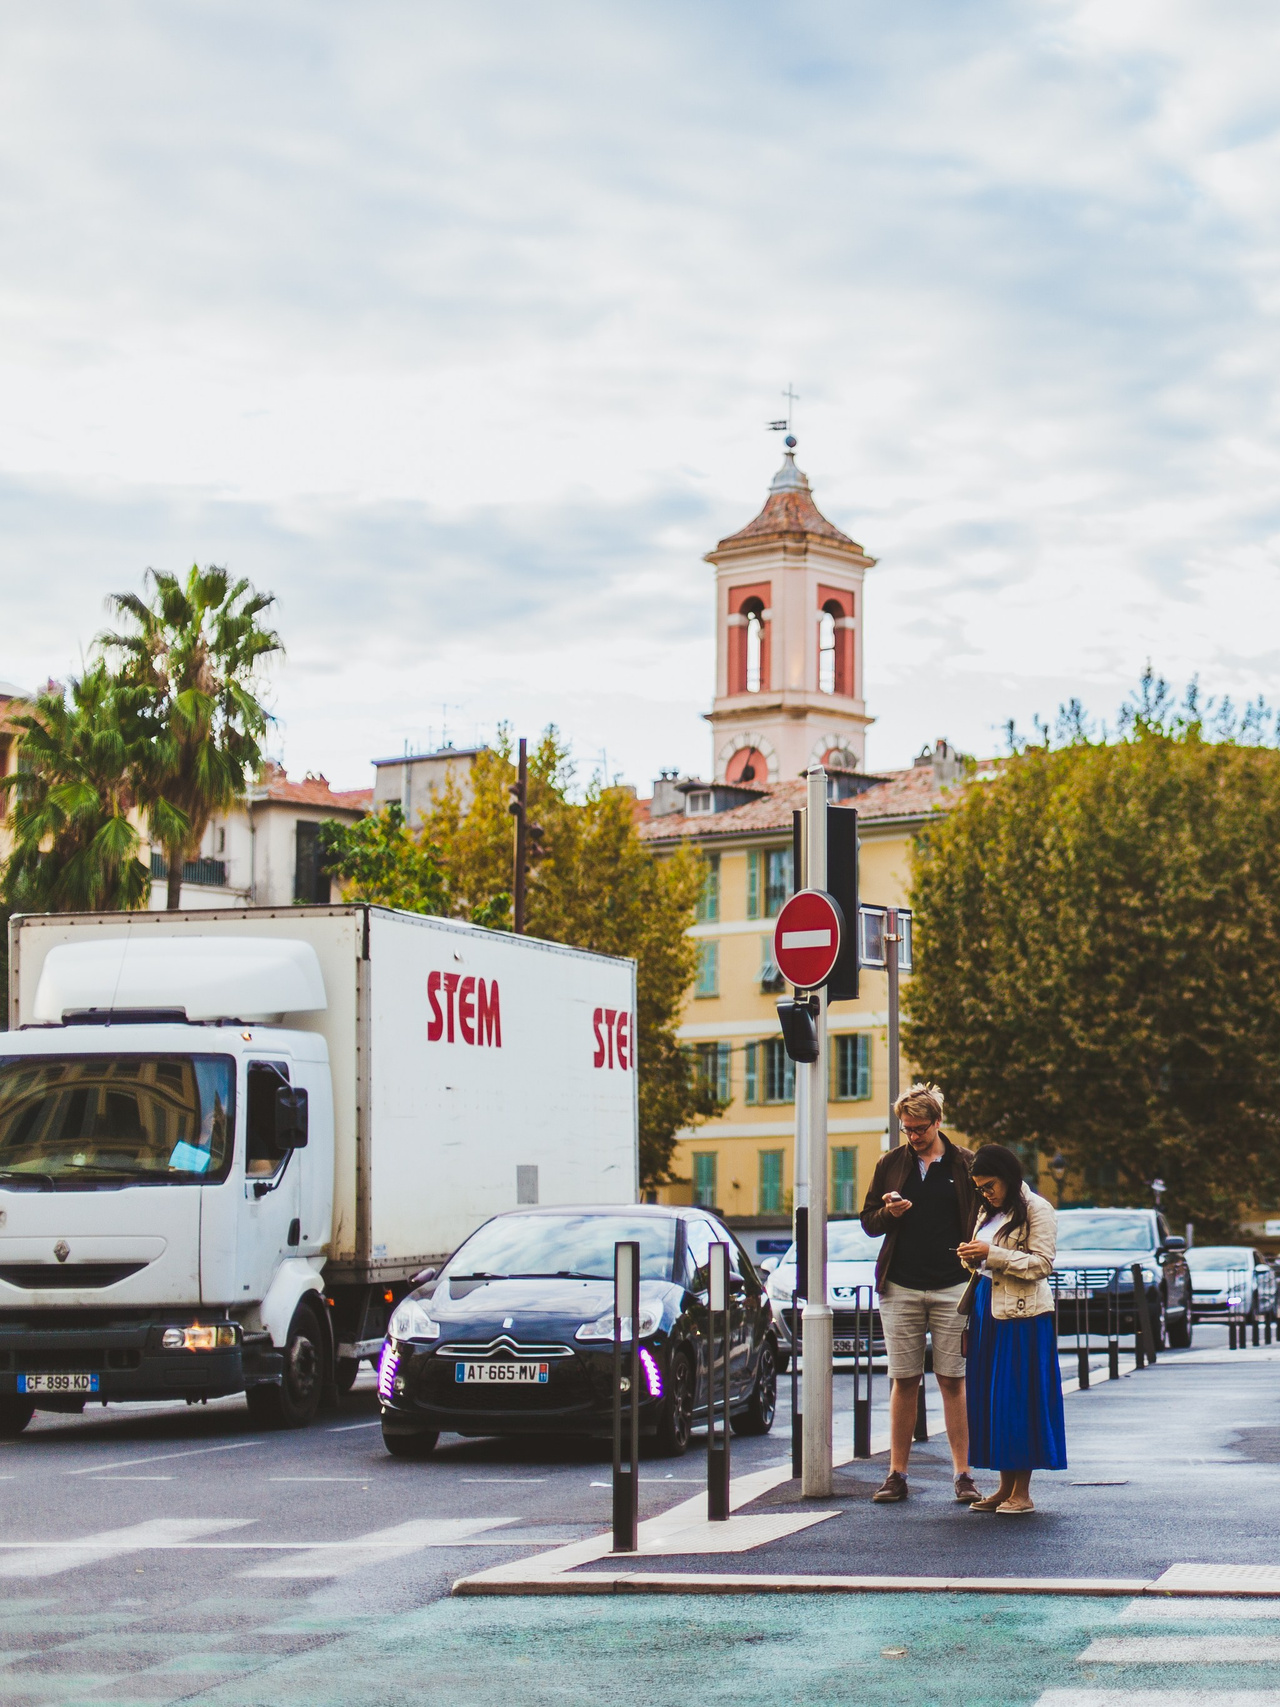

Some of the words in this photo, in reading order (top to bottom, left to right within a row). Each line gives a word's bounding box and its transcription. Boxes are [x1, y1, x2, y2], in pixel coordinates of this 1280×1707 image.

[427, 970, 502, 1048] STEM
[593, 1007, 633, 1071] STE
[26, 1376, 90, 1389] CF-899-KD
[467, 1365, 537, 1380] AT-665-MV
